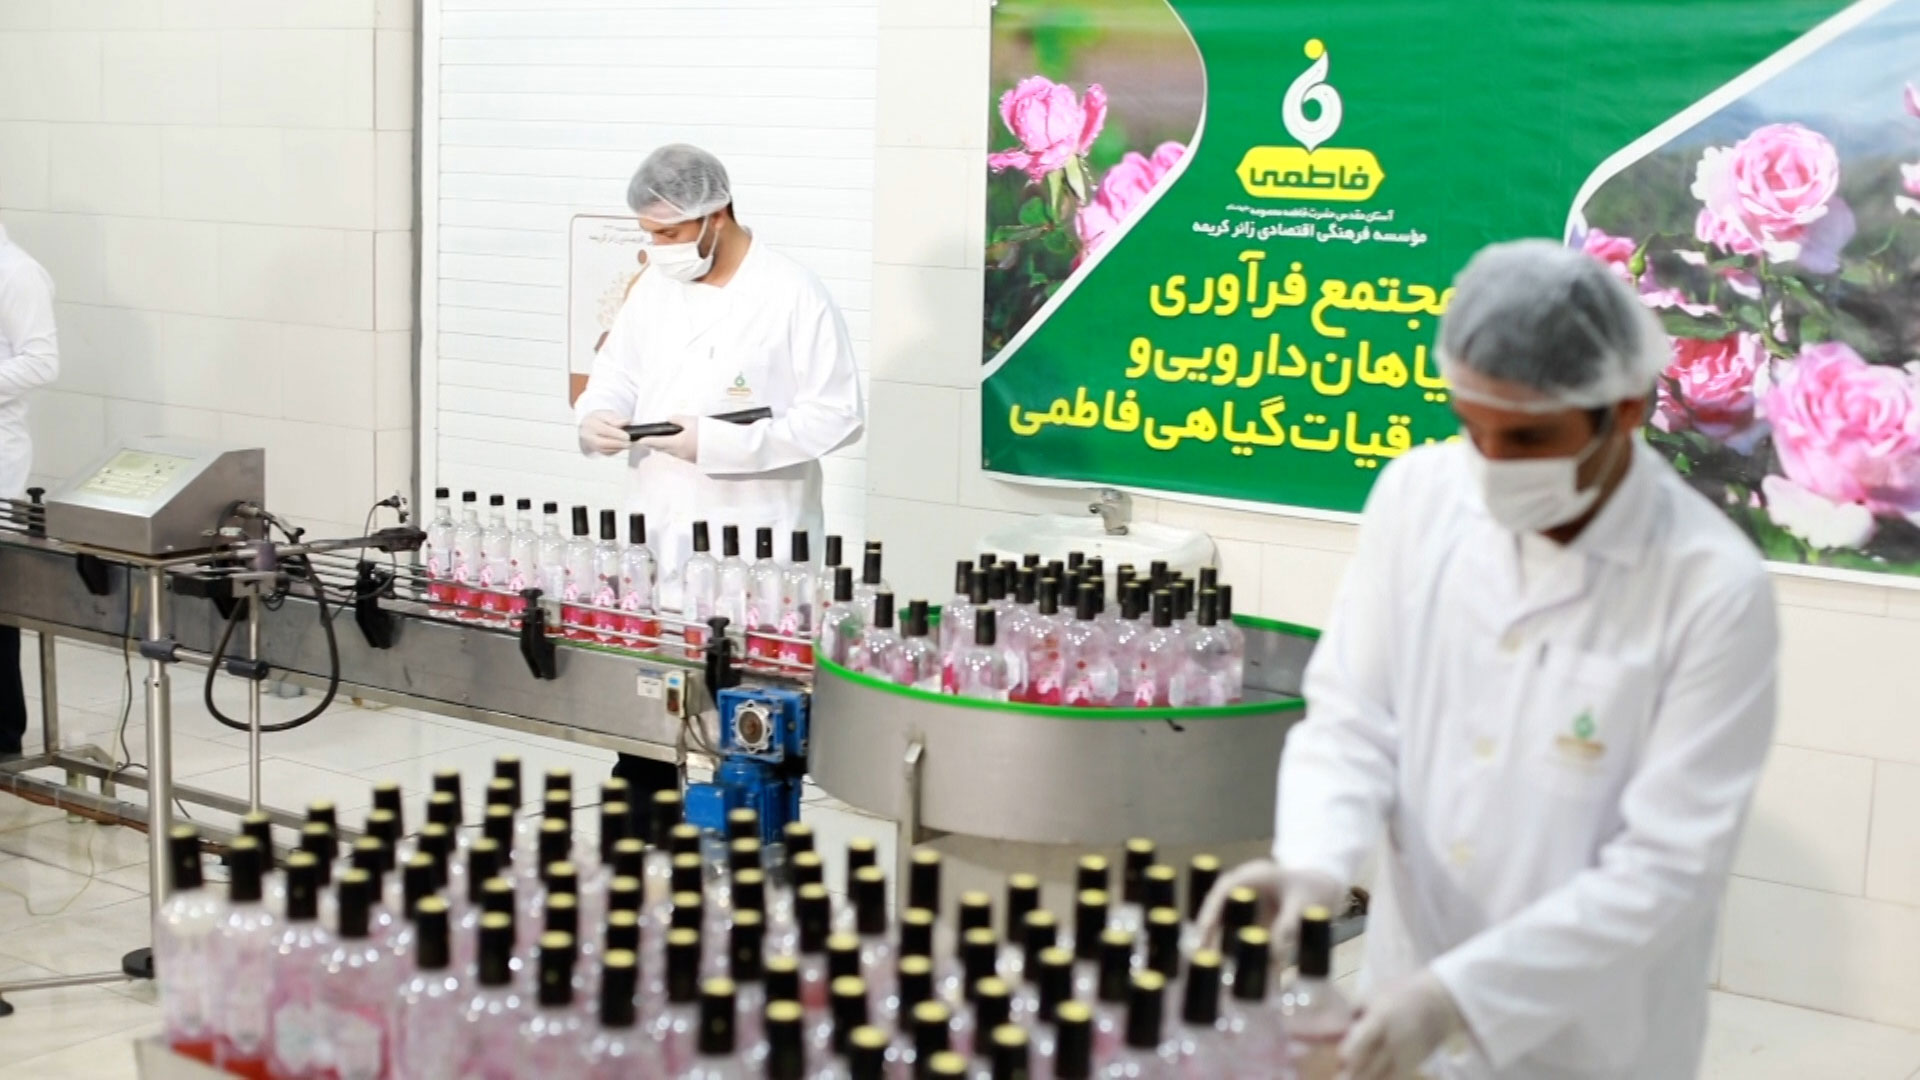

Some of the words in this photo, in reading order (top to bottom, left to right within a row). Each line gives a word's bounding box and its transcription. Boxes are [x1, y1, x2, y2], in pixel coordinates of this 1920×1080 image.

[1250, 163, 1370, 190] فاطمی
[1192, 219, 1230, 237] کریمه
[1256, 222, 1316, 241] اقتصادی
[1316, 223, 1370, 243] فرهنگی
[1149, 250, 1307, 319] فرآوری
[1153, 333, 1308, 388] دارویی
[1311, 339, 1457, 403] یاهان
[1009, 386, 1141, 436] فاطمی
[1143, 395, 1287, 456] گیاهی
